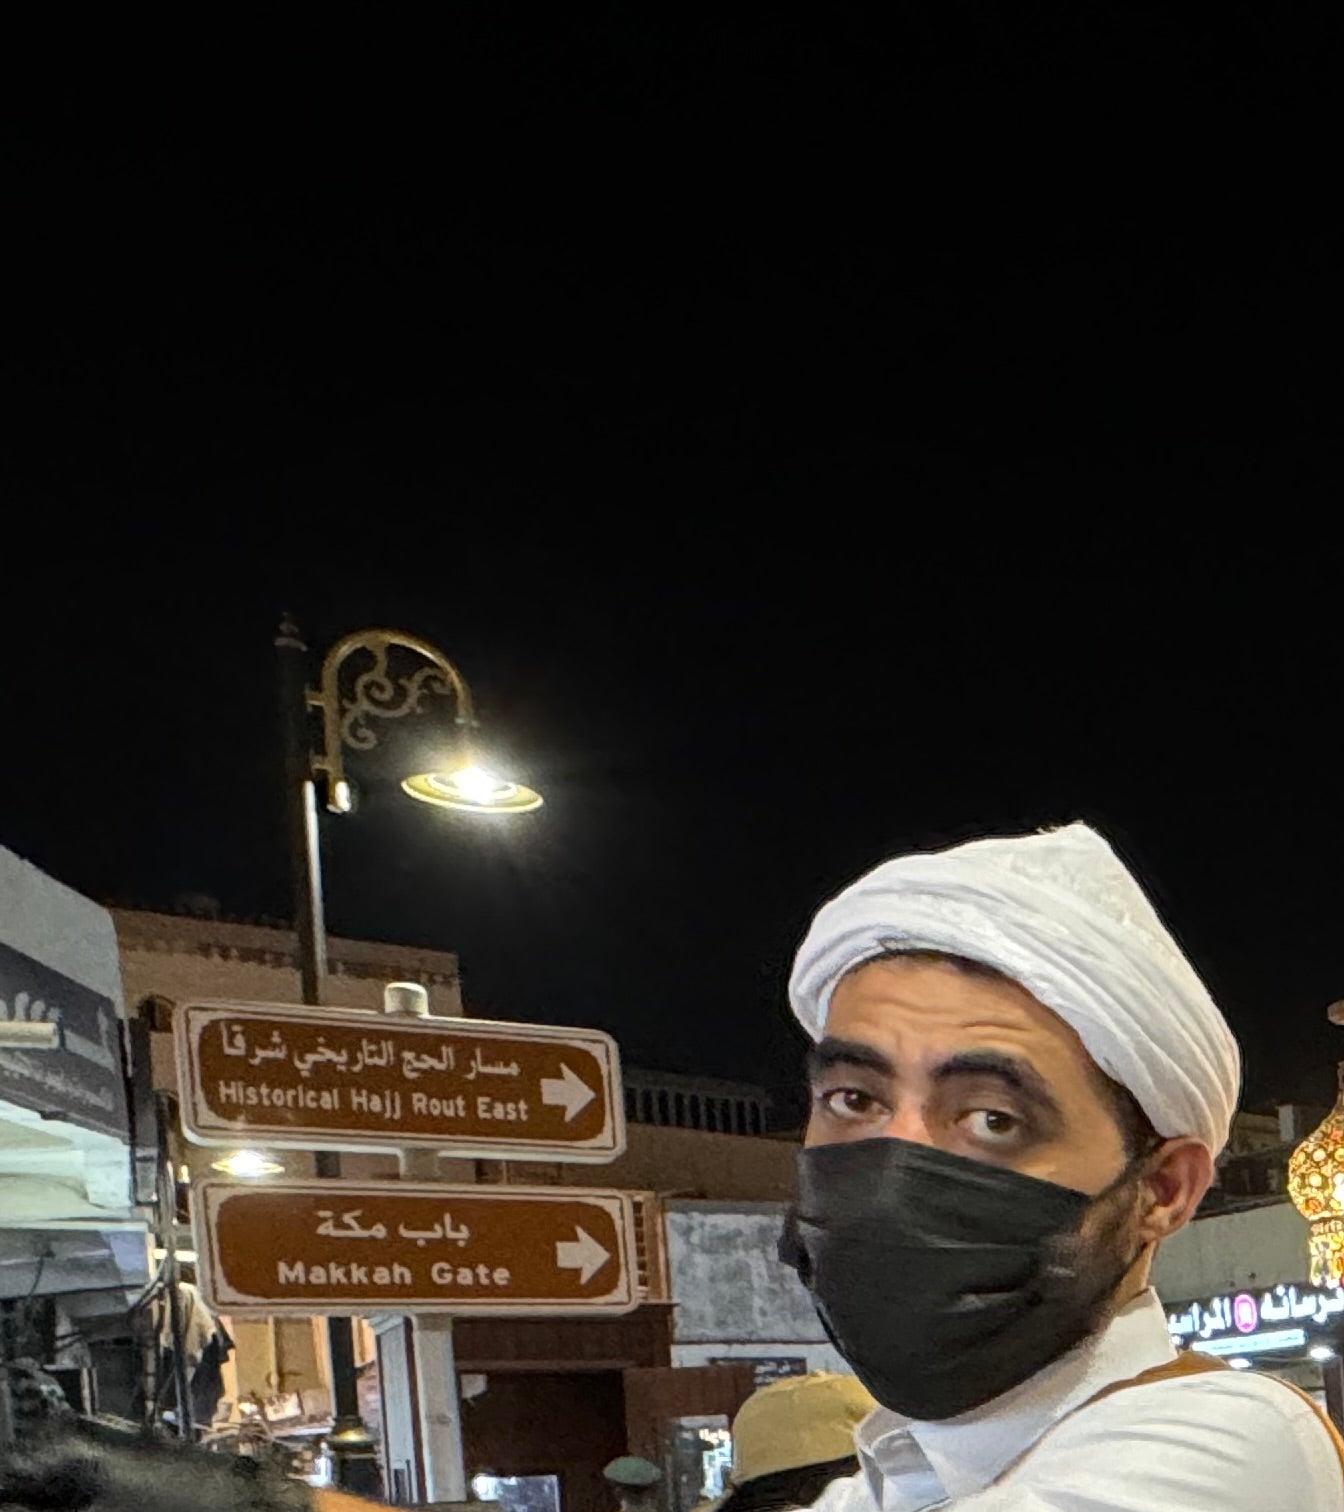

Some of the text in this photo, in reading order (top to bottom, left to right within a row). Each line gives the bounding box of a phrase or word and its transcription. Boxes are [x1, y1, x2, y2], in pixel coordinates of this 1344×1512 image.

[293, 1035, 395, 1078] التاريخي
[400, 1045, 454, 1079] الحج
[465, 1046, 522, 1080] مسار
[218, 1079, 528, 1121] Historical Hajj Rout East
[314, 1209, 471, 1248] باب مكة
[277, 1261, 512, 1287] Makkah Gate
